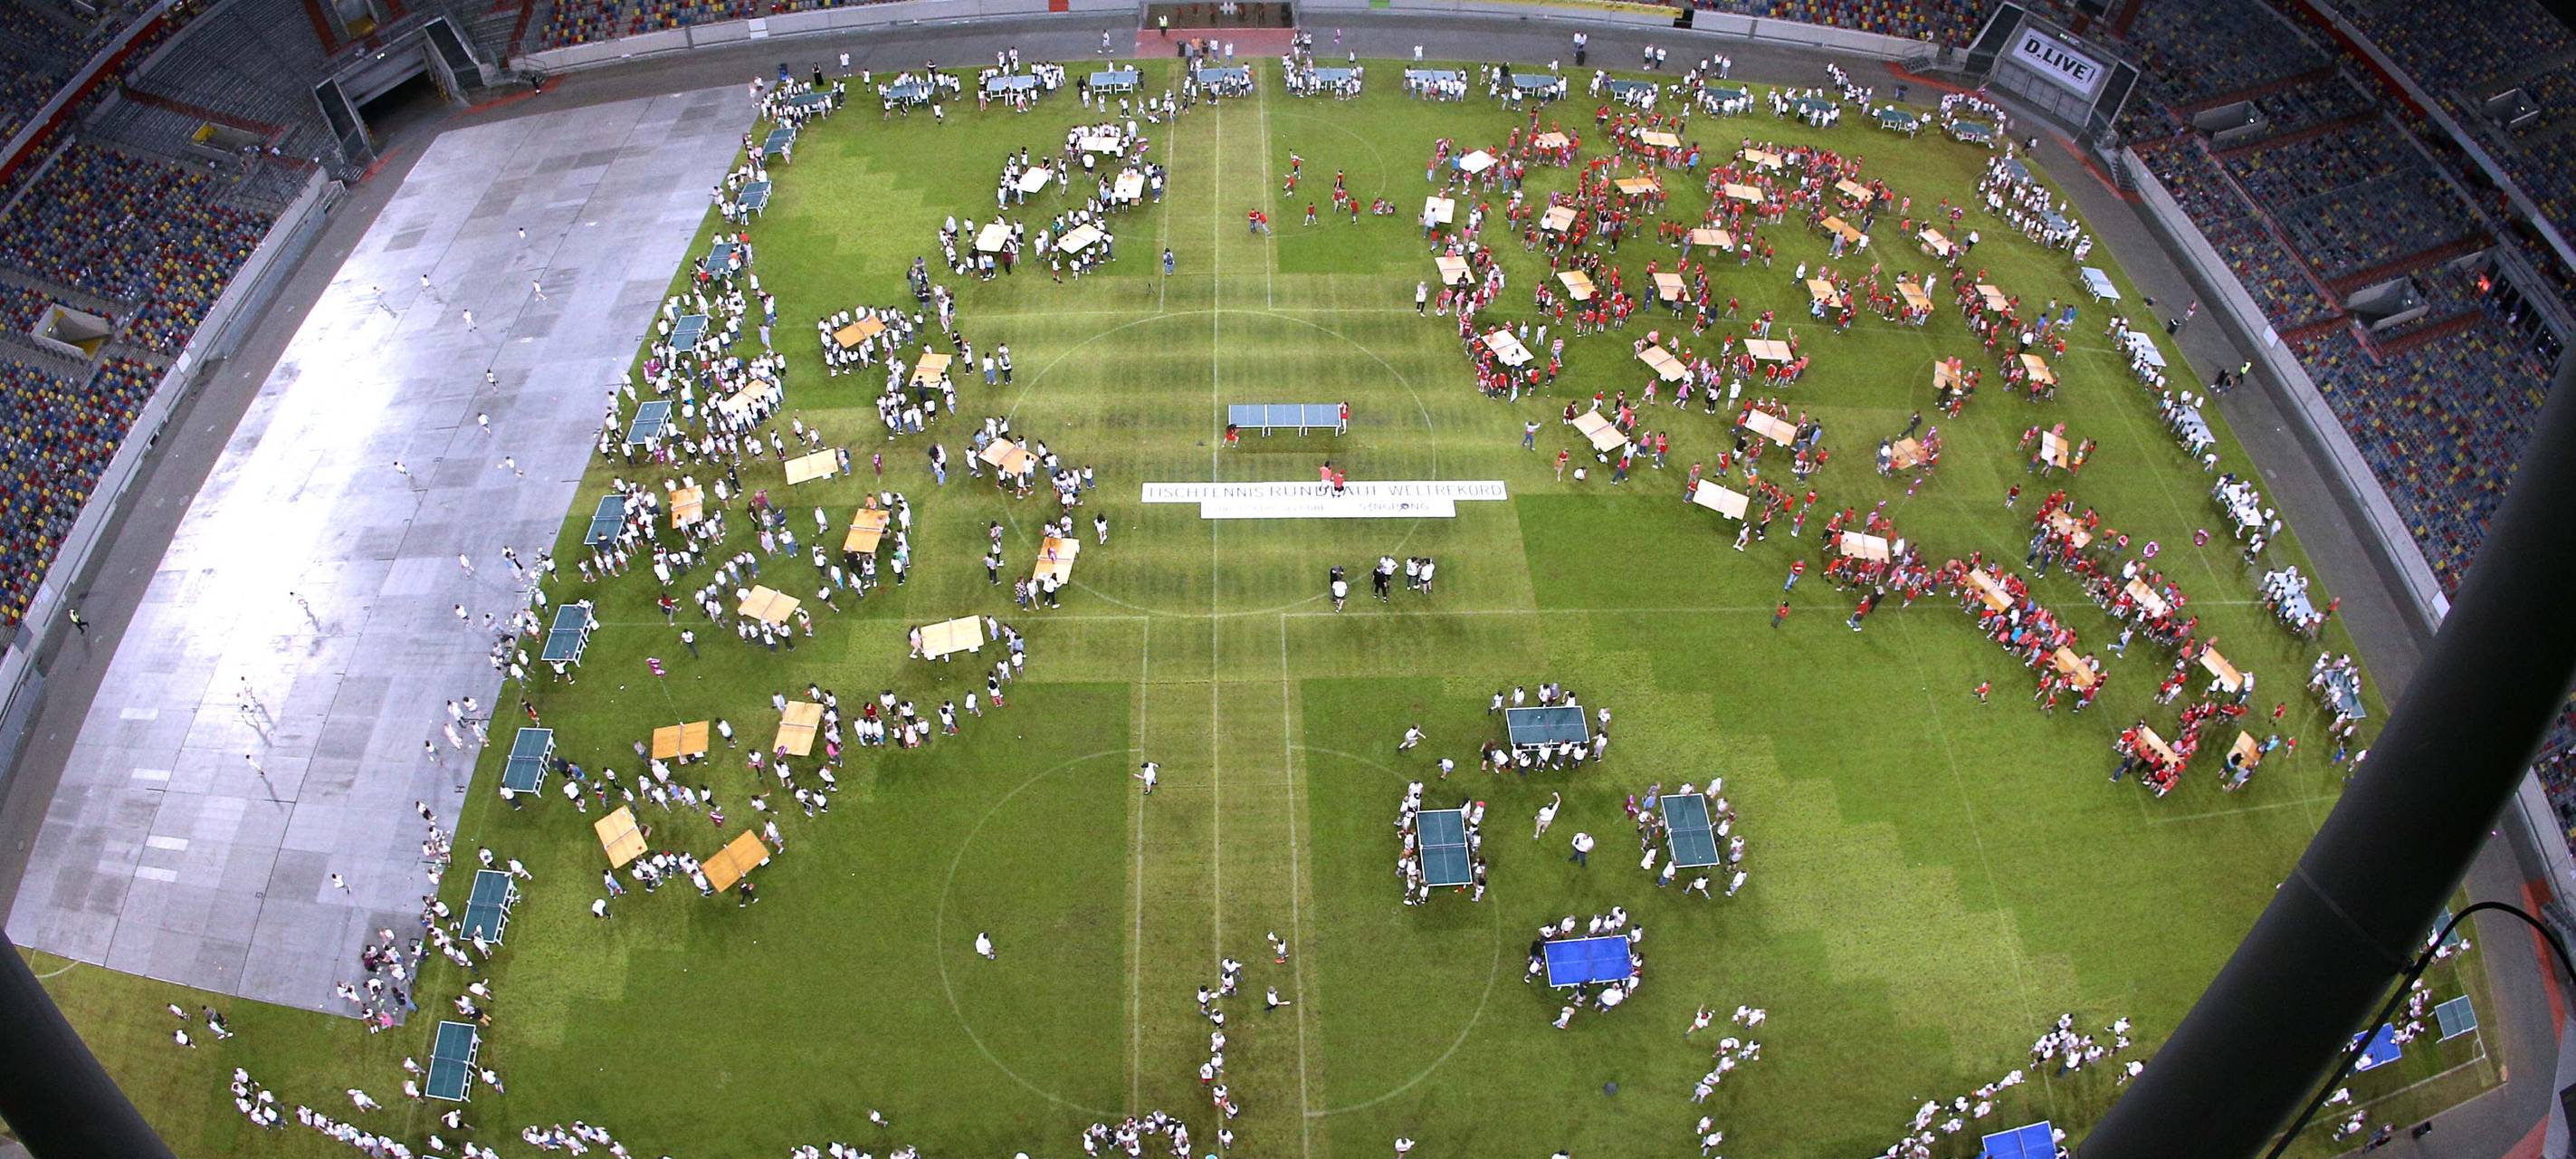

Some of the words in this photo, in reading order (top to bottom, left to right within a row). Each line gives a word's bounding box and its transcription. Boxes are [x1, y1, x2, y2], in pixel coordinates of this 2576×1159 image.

[2025, 39, 2087, 80] D.LIVE
[1150, 486, 1264, 498] TISCHTENNIS
[1388, 484, 1503, 496] WELTREKORD
